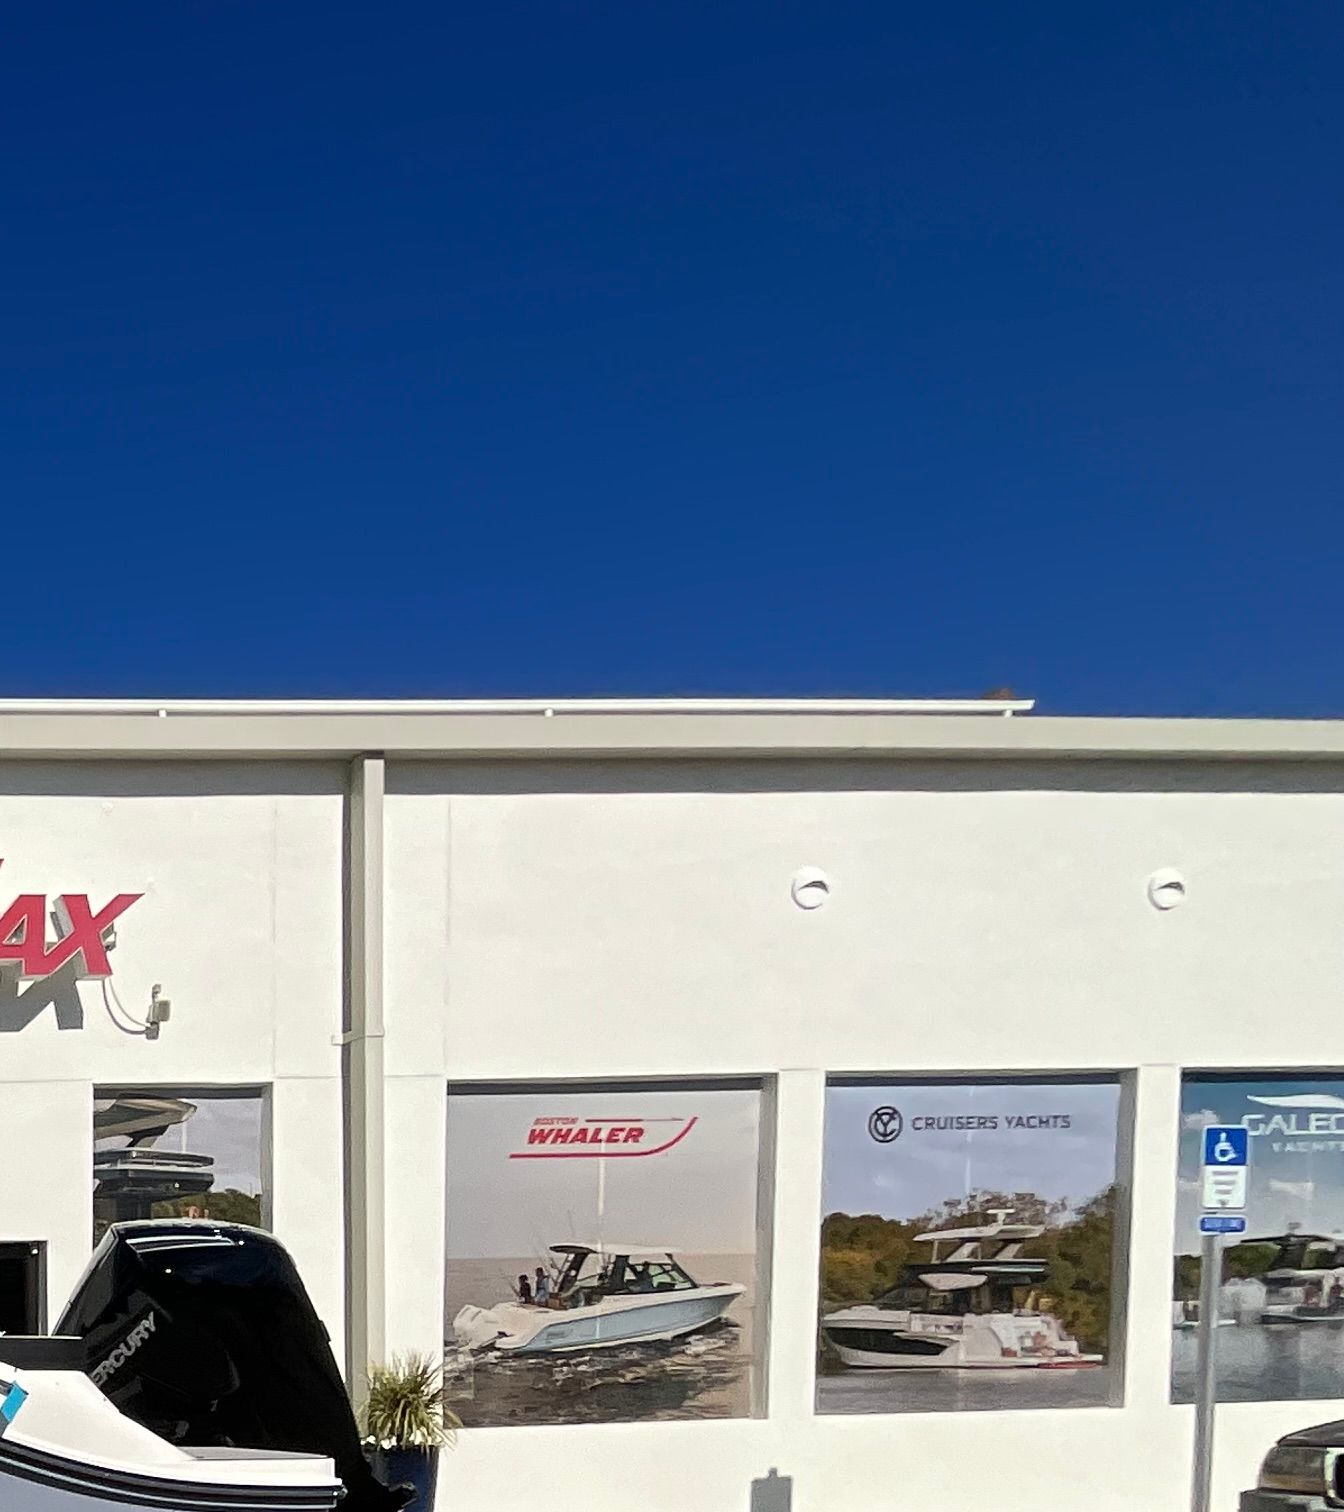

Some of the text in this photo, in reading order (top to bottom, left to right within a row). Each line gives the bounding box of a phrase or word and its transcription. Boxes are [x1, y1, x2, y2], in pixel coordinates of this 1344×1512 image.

[911, 1114, 1072, 1131] CRUISERS YACHTS
[527, 1127, 645, 1145] WHALER
[91, 1311, 157, 1388] ERCURY
